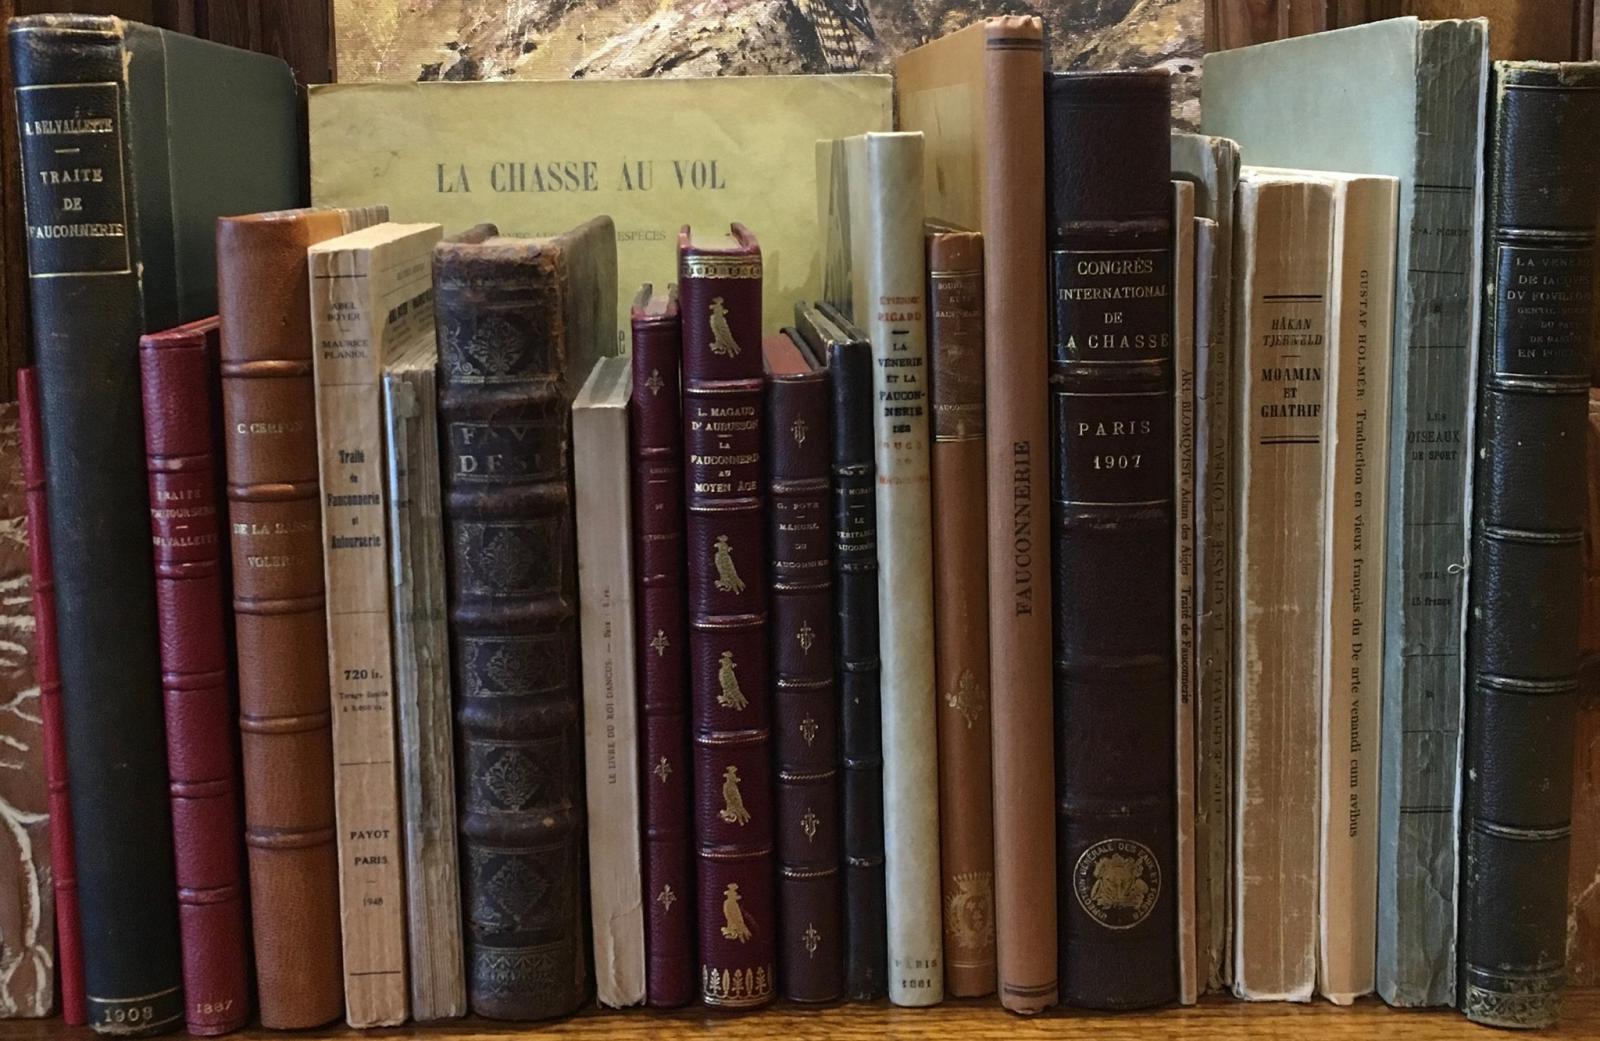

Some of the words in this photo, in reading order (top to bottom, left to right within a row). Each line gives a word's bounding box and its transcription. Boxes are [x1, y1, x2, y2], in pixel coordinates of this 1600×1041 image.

[435, 161, 472, 193] LA
[490, 160, 599, 193] CHASSE
[617, 158, 654, 192] AU
[673, 159, 726, 190] VOL
[63, 197, 82, 211] DE
[1077, 257, 1154, 276] CONGRÈS
[1057, 285, 1169, 301] INTERNATIONAL
[1358, 269, 1369, 328] GUSTAF
[1104, 311, 1123, 325] DE
[1271, 316, 1312, 331] HÅKAN
[892, 342, 908, 352] LA
[1088, 333, 1169, 350] CHASSE
[886, 374, 900, 384] ET
[903, 374, 917, 384] LA
[1261, 367, 1322, 382] MOAMIN
[1283, 387, 1298, 399] ET
[710, 406, 756, 417] MAGAUD
[884, 406, 923, 418] NERIE
[1260, 403, 1322, 418] GHATRIF
[1426, 411, 1447, 422] LES
[892, 423, 912, 434] DES
[1077, 420, 1152, 437] PARIS
[1407, 430, 1462, 444] OISEAUX
[719, 441, 731, 449] LA
[1354, 408, 1367, 486] Traduction
[338, 448, 365, 464] Traité
[1411, 450, 1424, 461] DE
[1428, 449, 1457, 461] SPORT
[1093, 455, 1142, 471] 1907
[349, 473, 358, 483] de
[718, 469, 732, 477] AU
[694, 482, 731, 493] MOYEN
[327, 491, 381, 507] Fauconnerie
[1354, 490, 1363, 508] en
[251, 522, 270, 536] LA
[1013, 441, 1033, 617] FAUCONNERIE
[1353, 514, 1365, 551] vieux
[1350, 558, 1364, 613] français
[1181, 623, 1192, 637] de
[1351, 616, 1363, 637] du
[1351, 641, 1363, 662] De
[343, 669, 368, 681] 720
[1181, 640, 1192, 705] Fauconnerie
[1350, 666, 1362, 694] arte
[606, 702, 615, 720] ROI
[1350, 699, 1362, 754] venandi
[608, 772, 617, 785] LE
[1349, 758, 1360, 789] cum
[1349, 793, 1361, 838] avibus
[350, 829, 390, 841] PAYOT
[354, 855, 389, 867] PARIS
